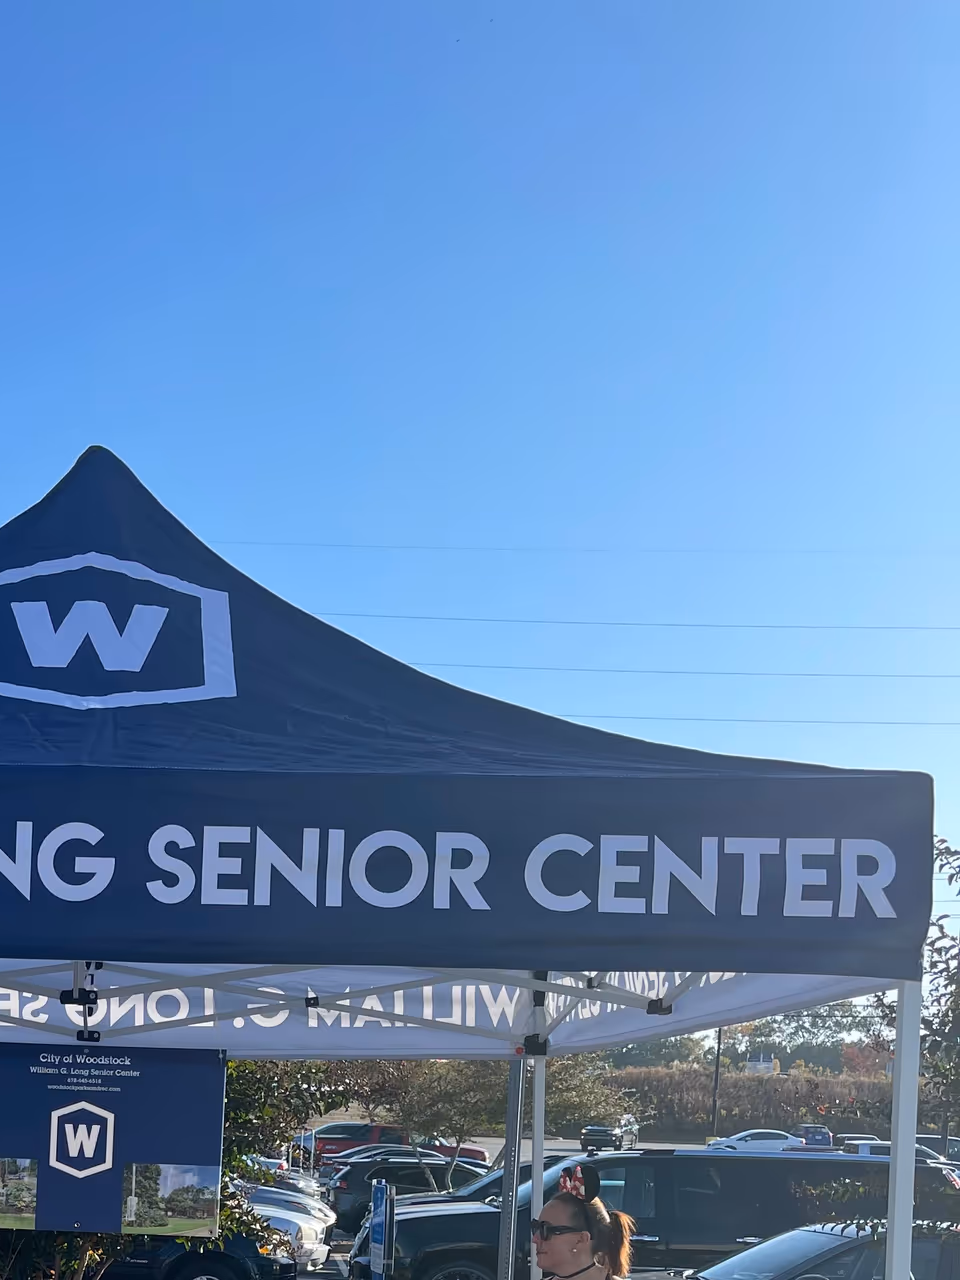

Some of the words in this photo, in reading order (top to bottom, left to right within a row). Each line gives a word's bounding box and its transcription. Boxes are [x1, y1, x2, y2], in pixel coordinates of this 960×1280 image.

[10, 600, 170, 672] W
[146, 824, 491, 910] SENIOR
[524, 833, 897, 919] CENTER
[29, 1066, 59, 1075] William
[60, 1067, 69, 1075] G.
[70, 1068, 89, 1077] Long
[90, 1068, 114, 1077] Senior
[115, 1069, 141, 1077] Center
[40, 1053, 61, 1065] City
[63, 1054, 73, 1064] of
[76, 1054, 132, 1065] Woodstock
[64, 1123, 101, 1158] W
